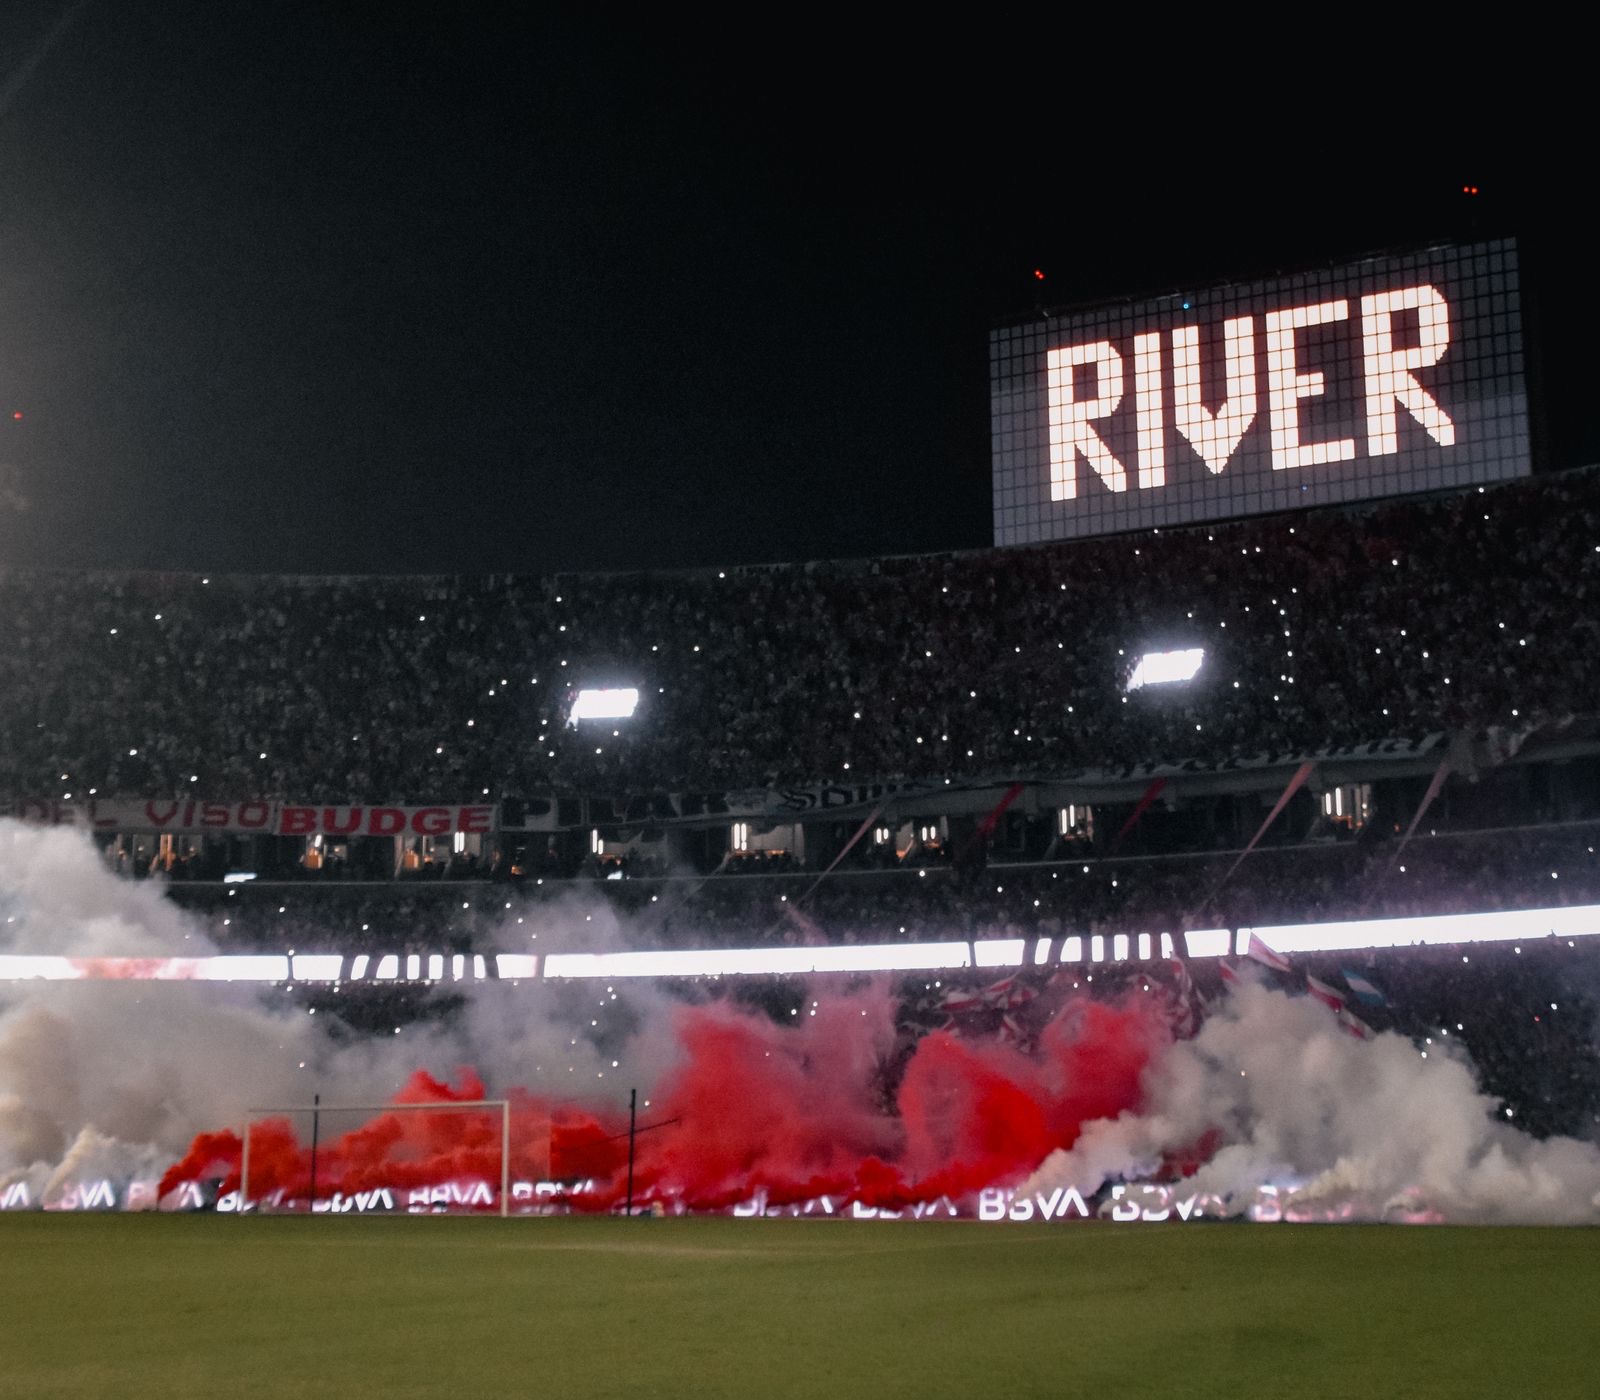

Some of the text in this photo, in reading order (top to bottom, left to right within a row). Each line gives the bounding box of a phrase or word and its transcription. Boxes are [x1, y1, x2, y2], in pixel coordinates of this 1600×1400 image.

[1046, 284, 1456, 502] RIVER
[144, 799, 269, 828] VISO
[279, 806, 493, 836] BUDGE
[978, 1186, 1090, 1221] BBVA
